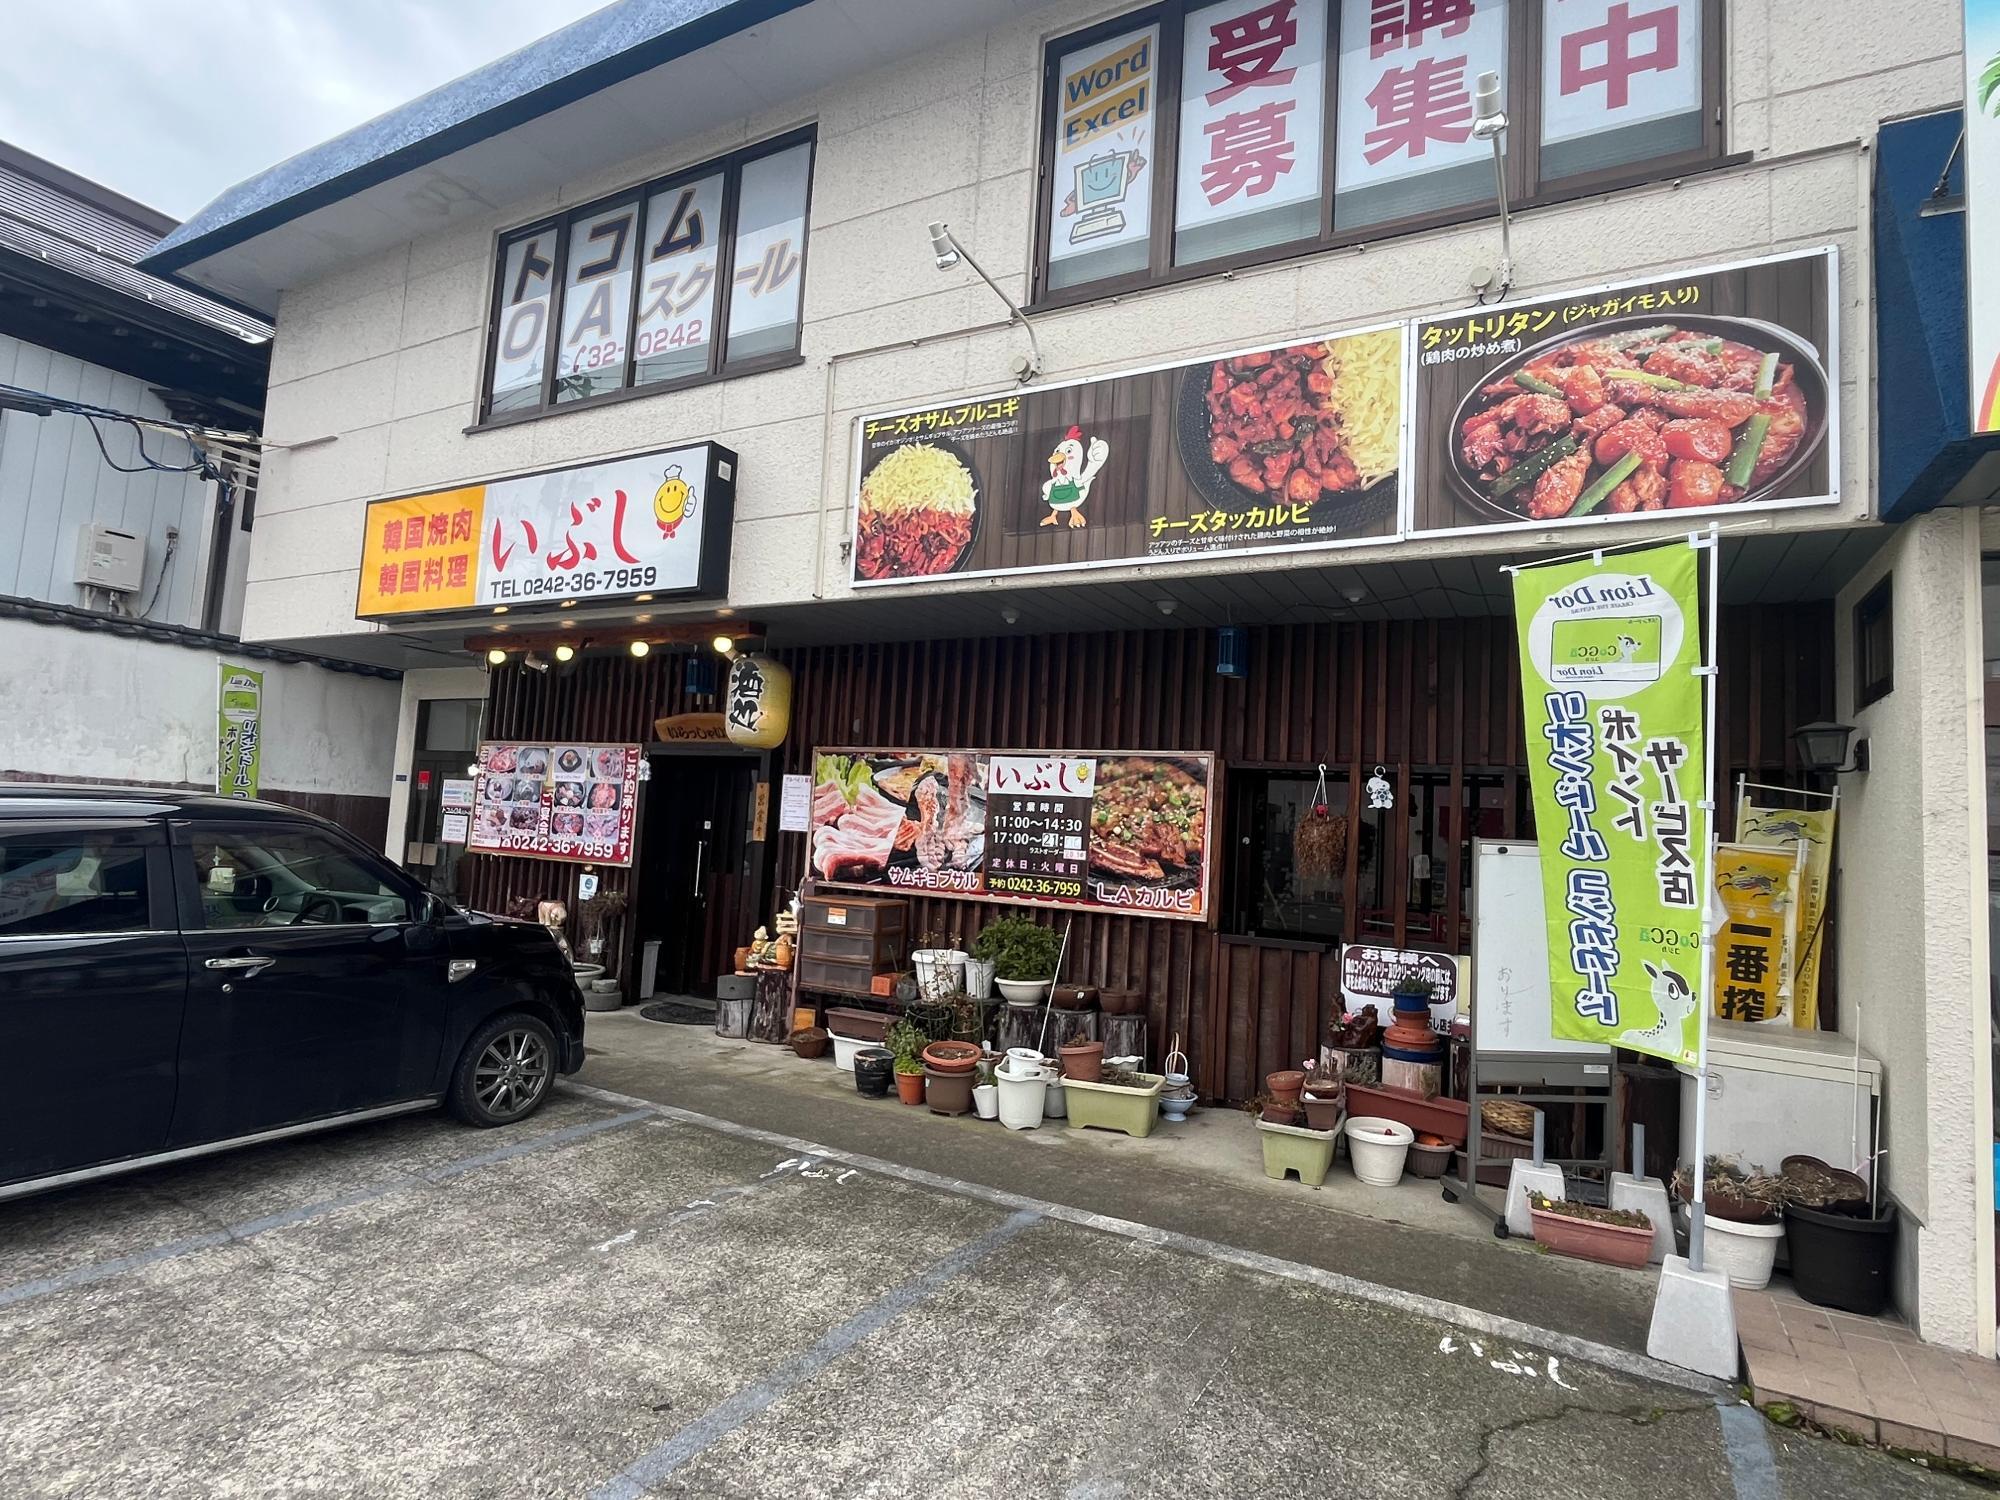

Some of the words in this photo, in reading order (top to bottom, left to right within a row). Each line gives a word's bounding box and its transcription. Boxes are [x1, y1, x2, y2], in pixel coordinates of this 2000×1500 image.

[1067, 44, 1150, 104] Word
[1066, 89, 1148, 145] Excel
[512, 188, 705, 303] トコム
[1421, 310, 1557, 350] タットリタン
[1563, 286, 1699, 324] (ジャガイモ入り)
[1421, 338, 1521, 366] (鶏肉の炒め煮)
[866, 397, 1020, 440] チーズオサムプルコギ
[382, 507, 472, 553] 韓国焼肉
[492, 490, 640, 572] いぶし
[1150, 501, 1313, 537] チーズタッカルビ
[378, 555, 468, 597] 韓国料理
[491, 580, 520, 599] TEL
[523, 566, 656, 596] 0242-36-7959
[995, 761, 1075, 795] いぶし
[1013, 800, 1064, 815] 営業時間
[889, 867, 979, 890] サムギョプサル
[989, 878, 1006, 889] 予約
[1007, 877, 1081, 896] 0242-36-7959
[1135, 889, 1193, 909] カルビ
[1362, 949, 1440, 967] お客様へ
